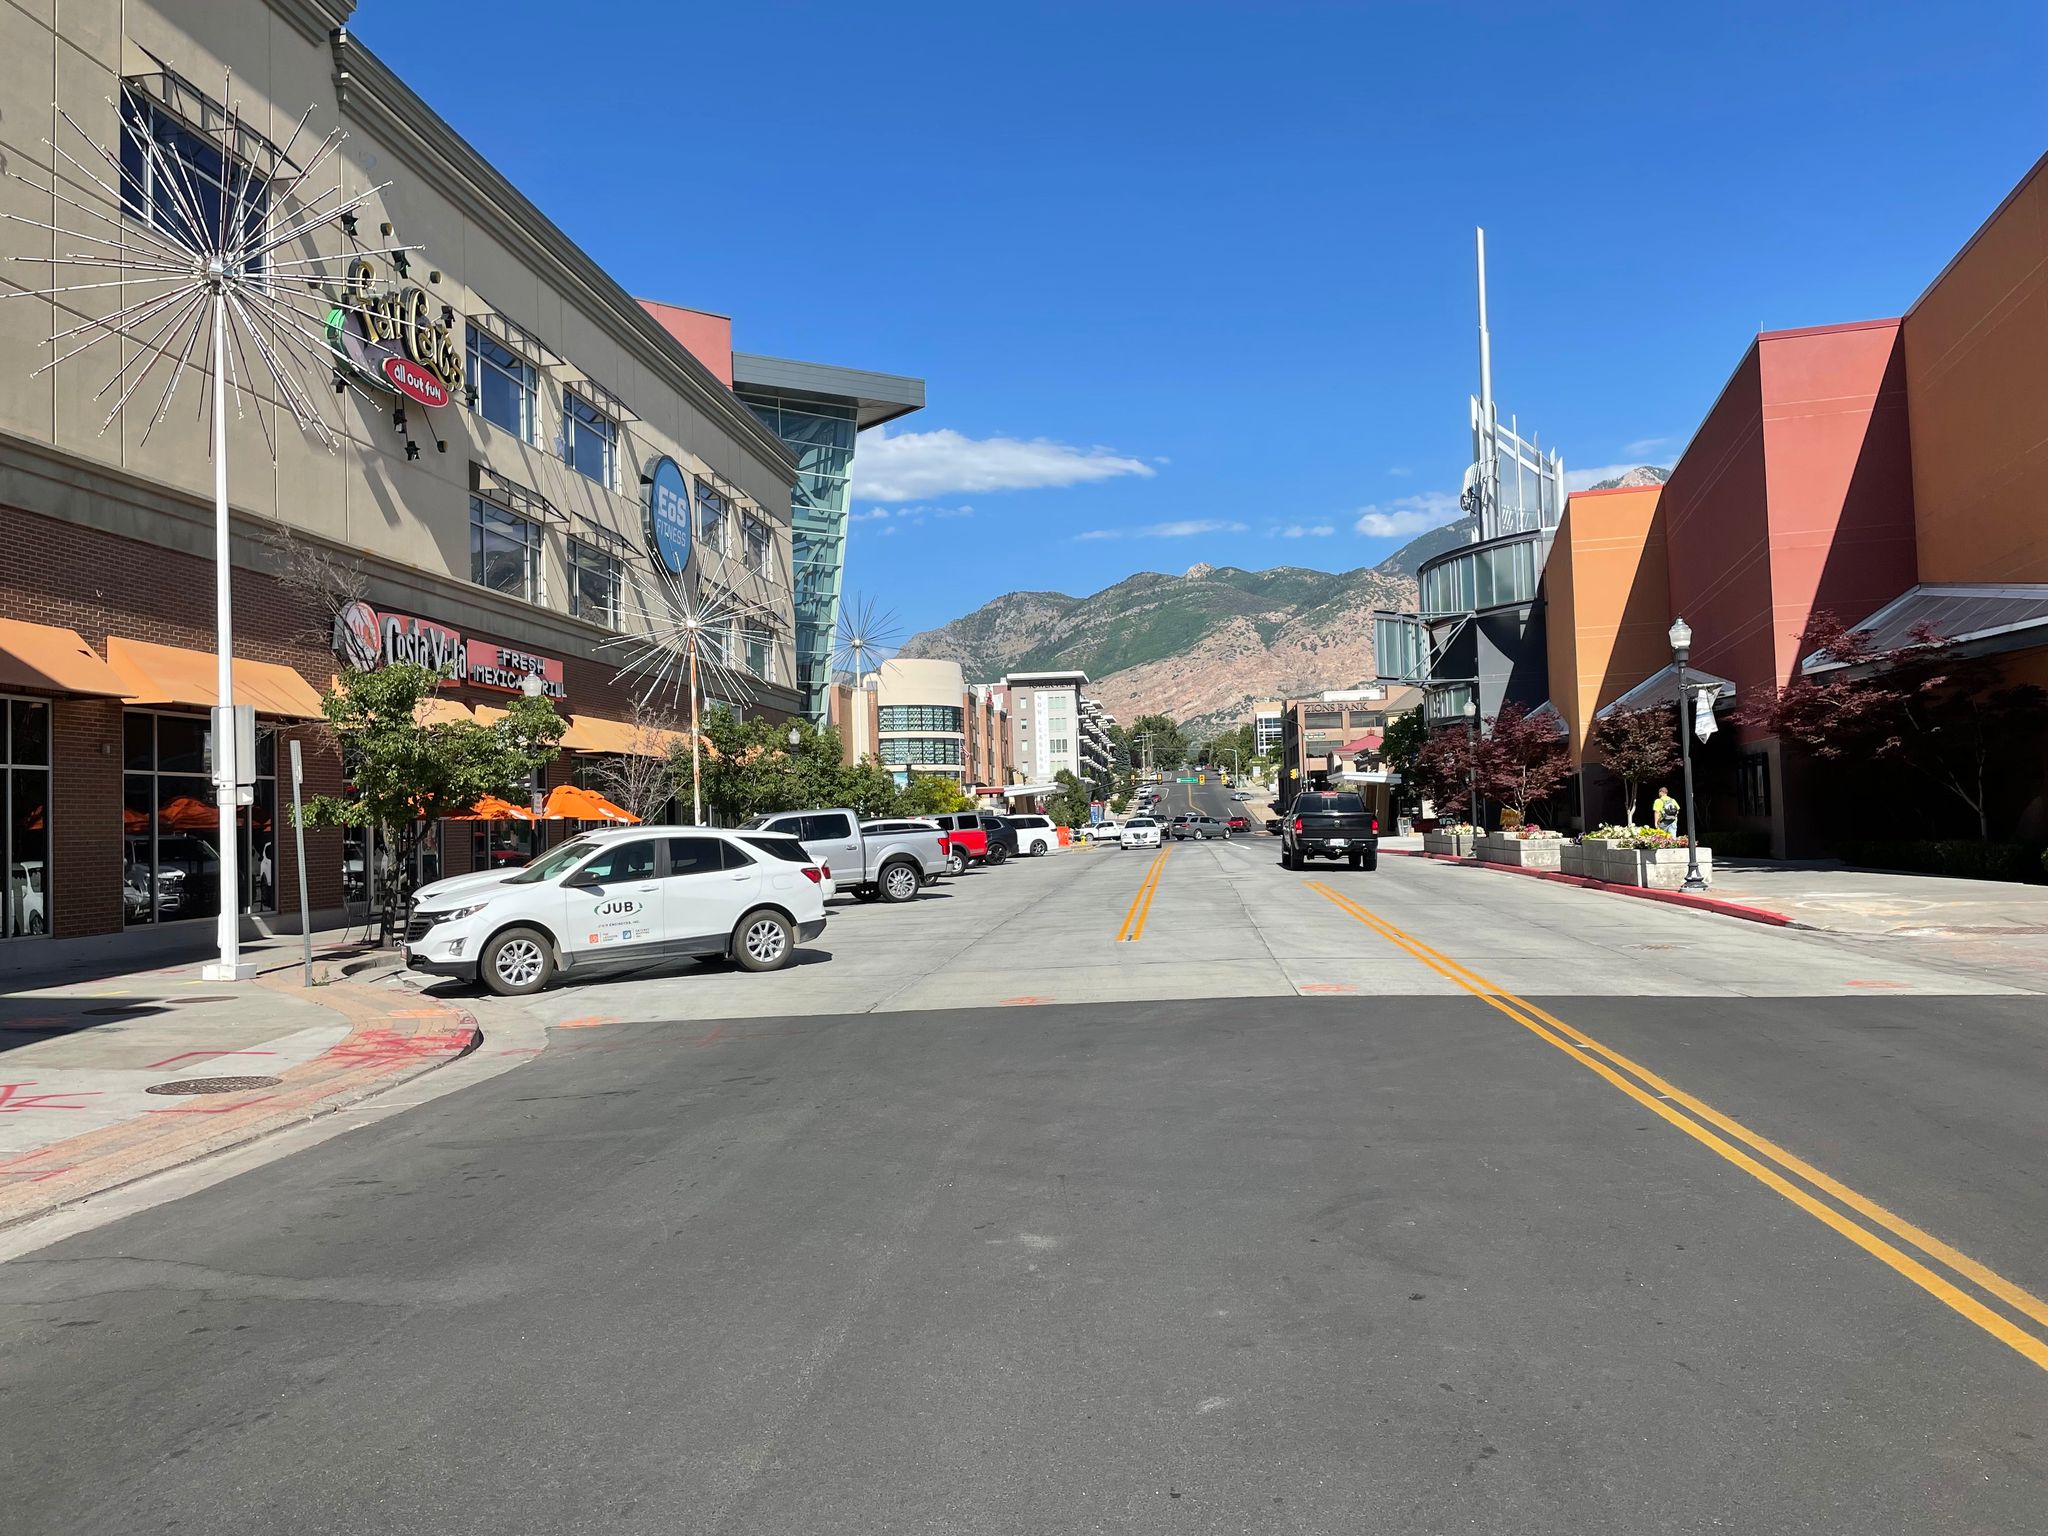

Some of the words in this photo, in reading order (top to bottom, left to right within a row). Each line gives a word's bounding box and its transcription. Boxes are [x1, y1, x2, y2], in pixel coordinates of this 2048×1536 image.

[394, 364, 405, 382] all
[408, 373, 424, 393] out
[656, 518, 686, 547] FITNESS
[386, 616, 429, 670] Costa
[501, 648, 545, 675] FRESH
[475, 665, 530, 692] MEXICA
[536, 679, 567, 698] RILL
[1304, 704, 1335, 713] ZIONS
[1337, 702, 1368, 712] BANK
[602, 901, 634, 914] JUB
